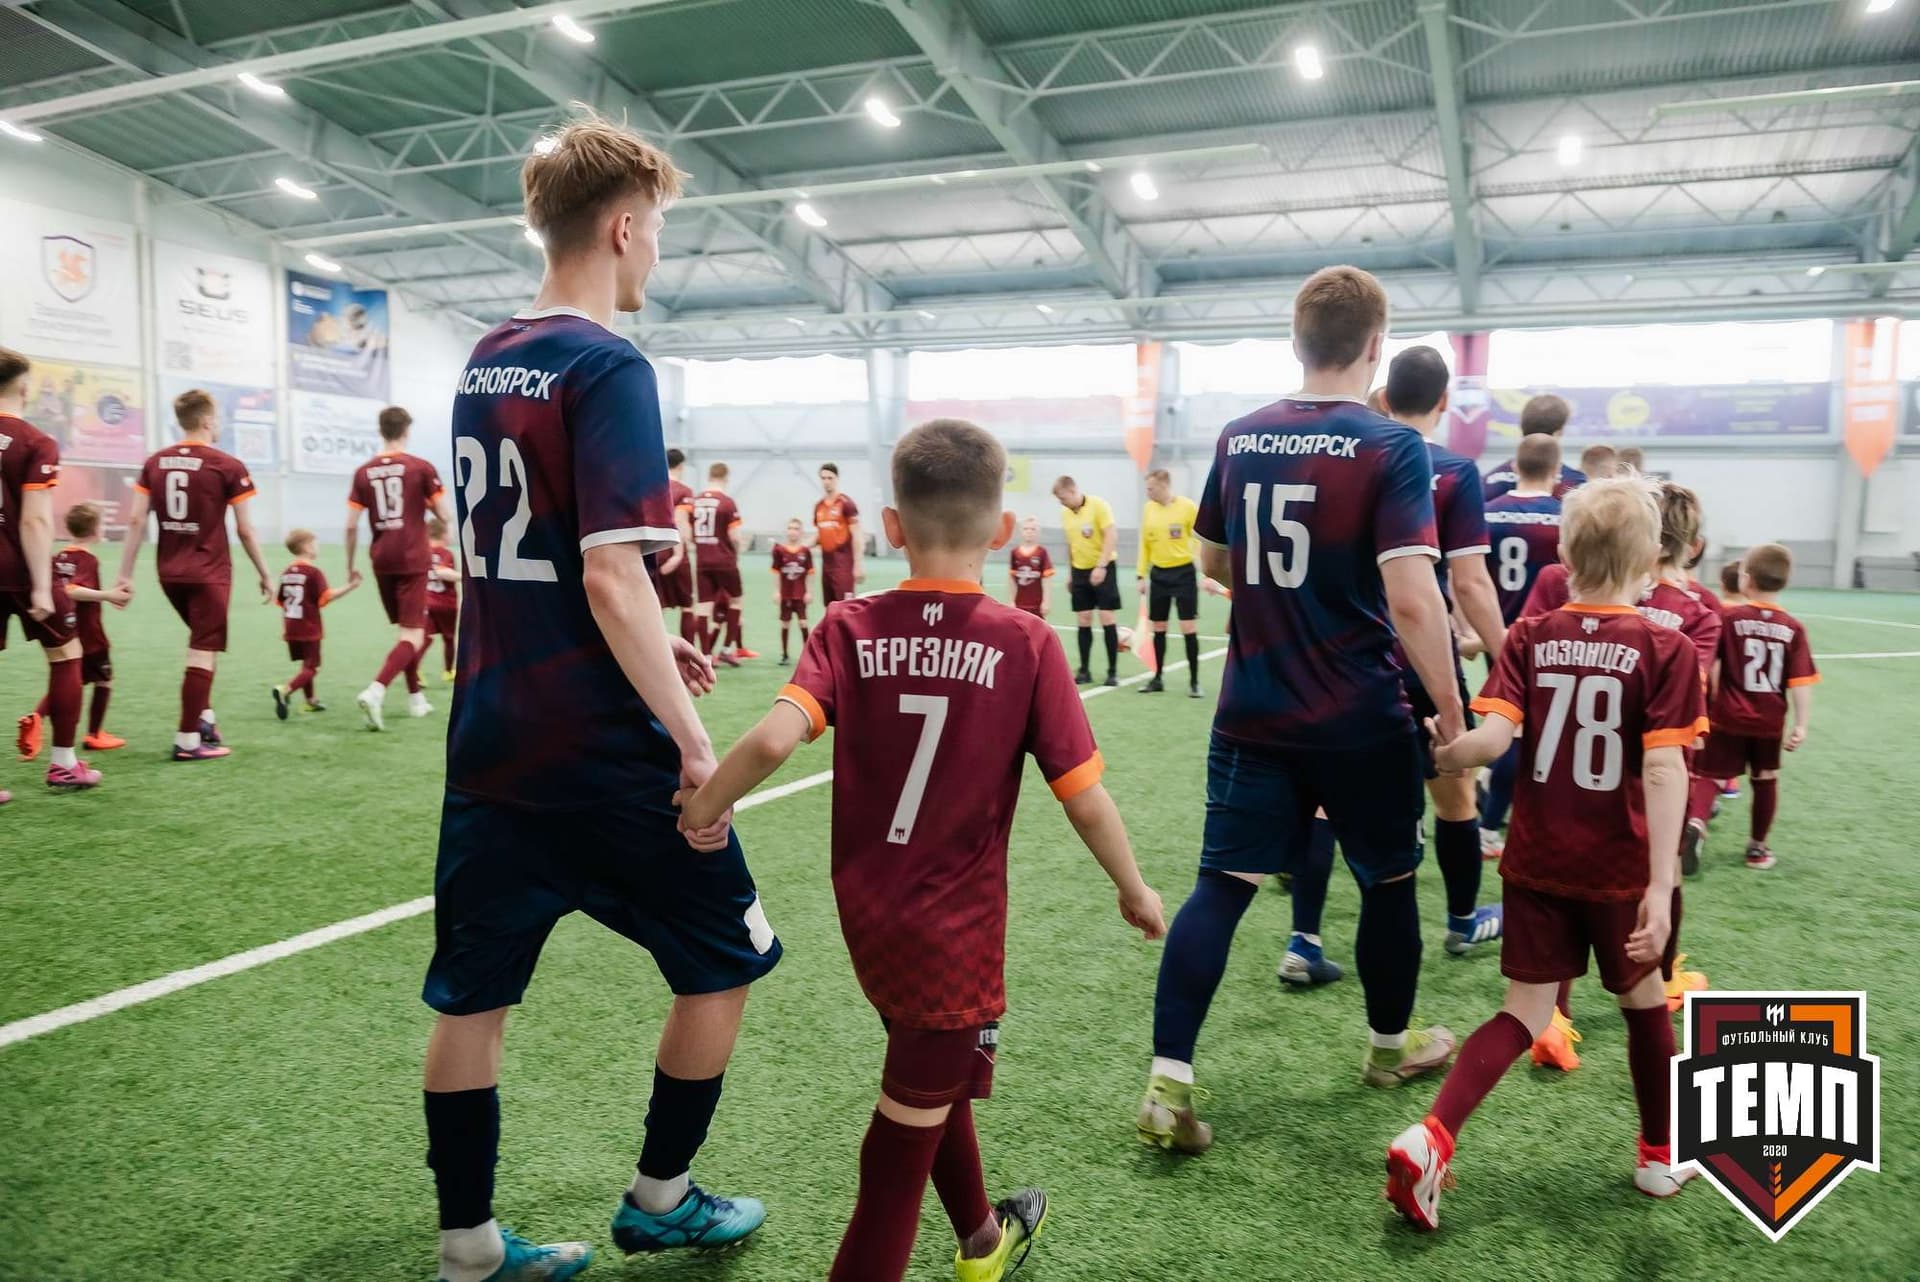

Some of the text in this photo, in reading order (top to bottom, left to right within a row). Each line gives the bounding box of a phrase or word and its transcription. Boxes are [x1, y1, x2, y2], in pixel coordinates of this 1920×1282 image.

[1227, 433, 1361, 458] КРАСНОЯРСК
[165, 471, 189, 521] 6
[455, 436, 560, 583] 22
[1242, 482, 1317, 589] 15
[1499, 536, 1529, 592] 8
[856, 637, 1005, 690] БЕРЕЗНЯК
[1533, 640, 1641, 676] КАЗАНЦЕВ
[1744, 637, 1785, 693] 21
[1531, 672, 1624, 792] 78
[886, 693, 949, 845] 7
